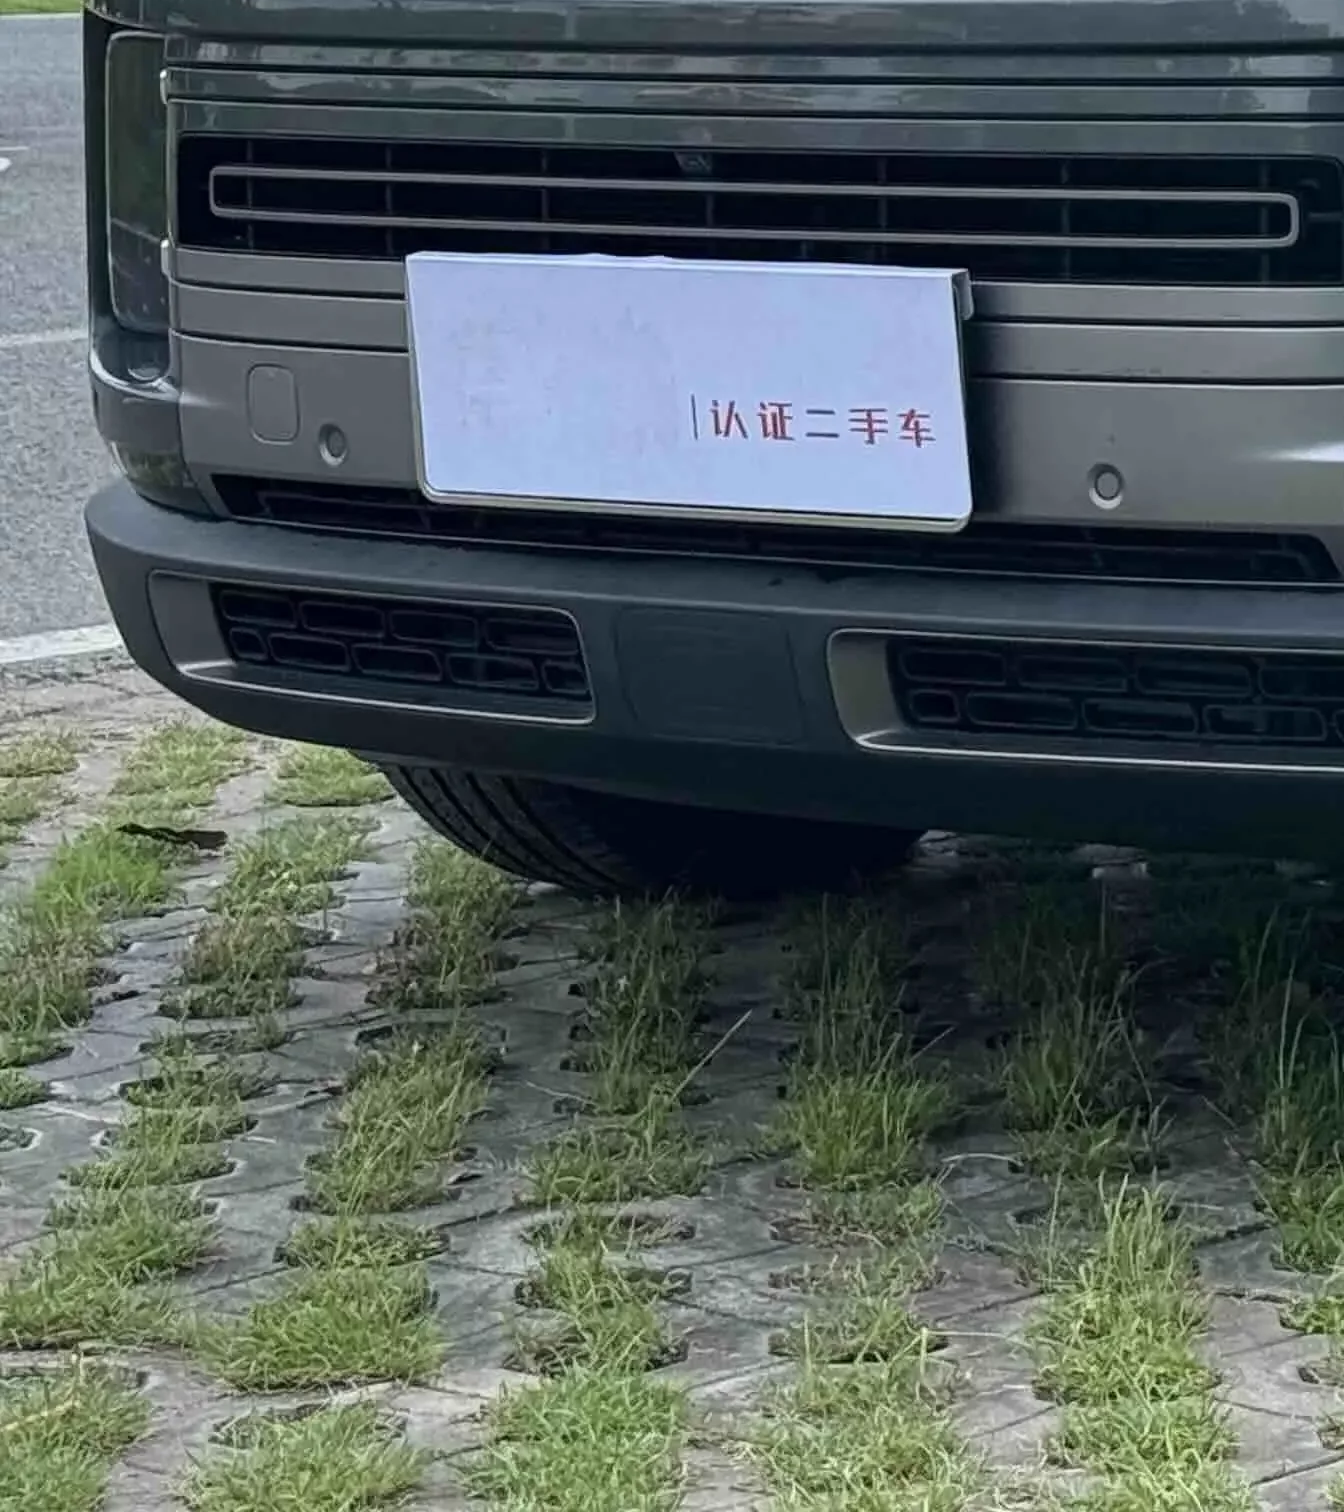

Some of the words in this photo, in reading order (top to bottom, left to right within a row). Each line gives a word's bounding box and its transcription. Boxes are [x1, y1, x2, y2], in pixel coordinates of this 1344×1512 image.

[709, 399, 936, 448] 认证二手车
